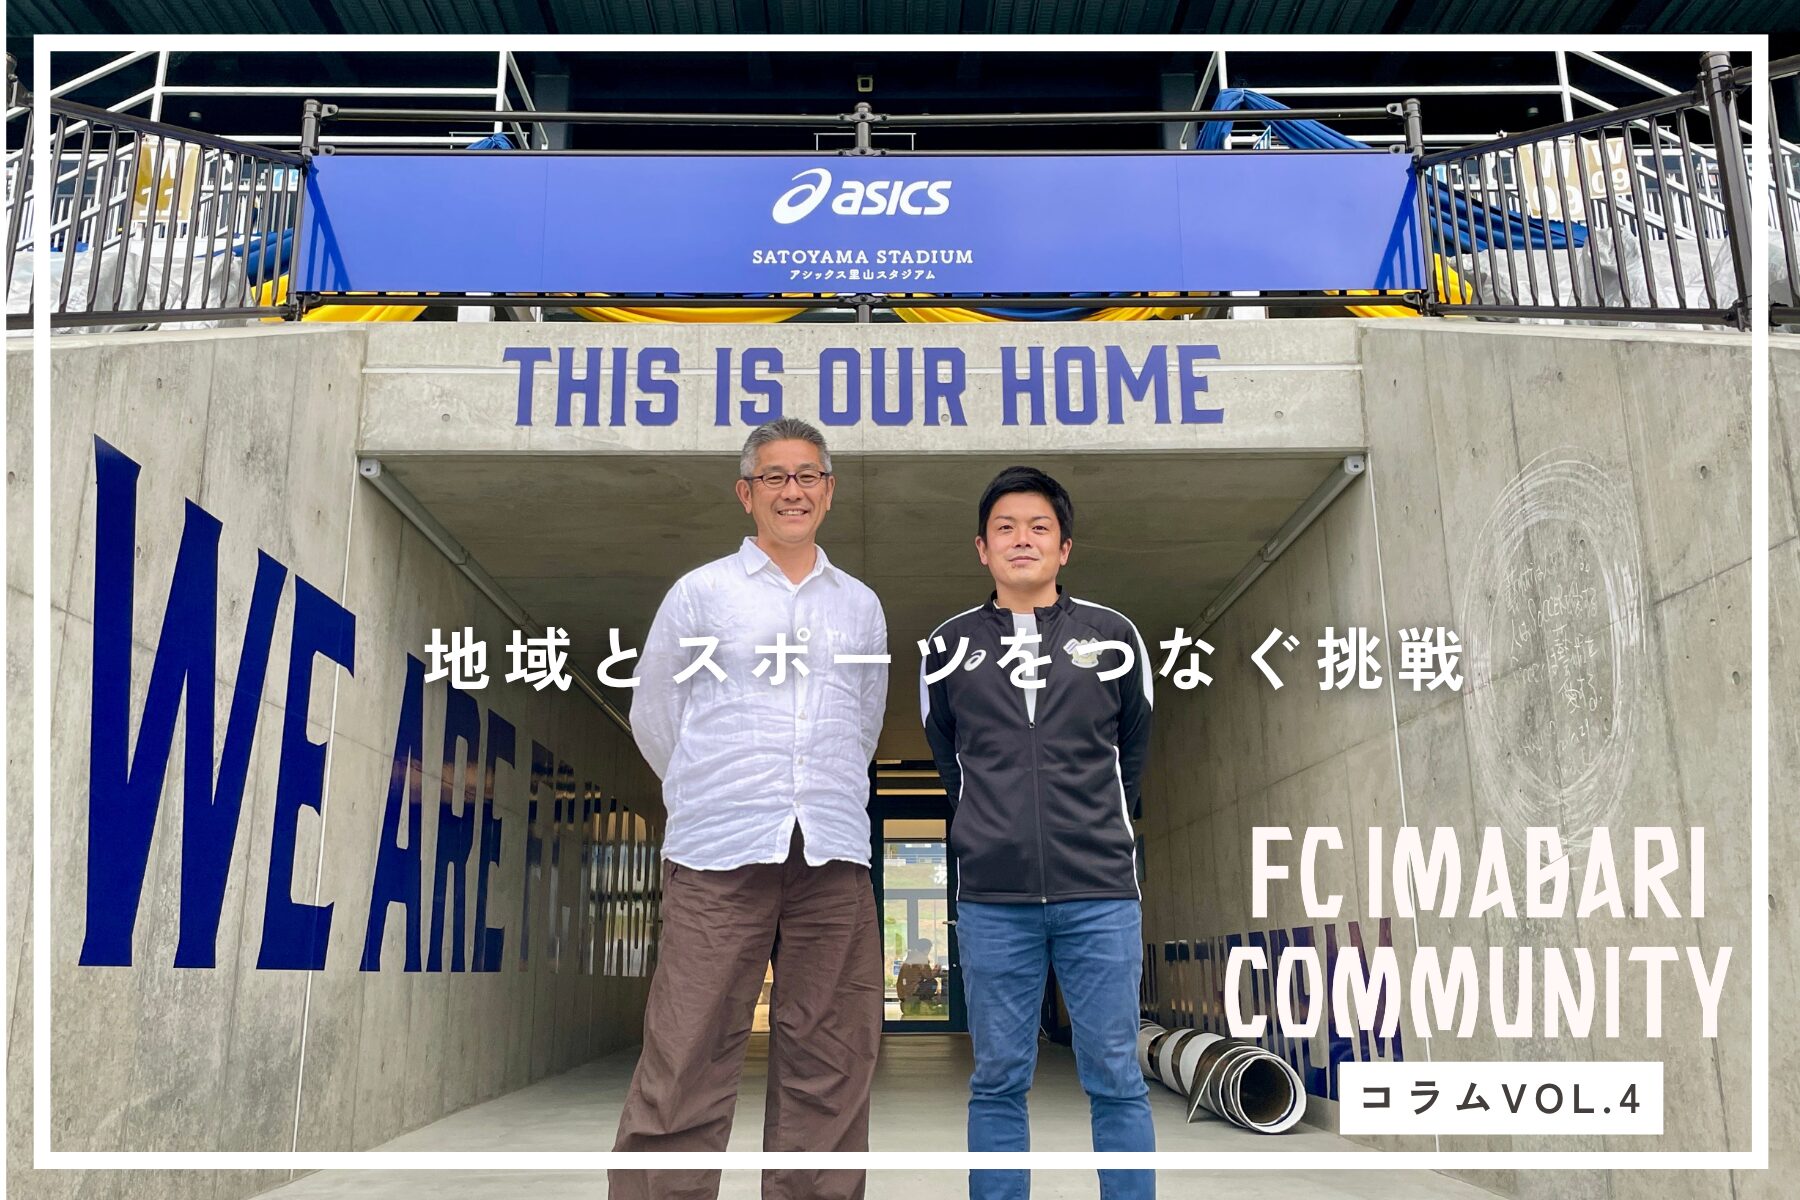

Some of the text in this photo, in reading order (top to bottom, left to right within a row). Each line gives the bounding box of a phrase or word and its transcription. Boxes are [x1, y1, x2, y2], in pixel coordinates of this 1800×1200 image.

[832, 180, 952, 215] asics
[752, 250, 973, 264] SATOYAMA STADIUM
[789, 269, 936, 280] アシックス里山スタジアム
[503, 345, 1225, 426] THIS IS OUR HOME
[78, 434, 356, 971] WE
[359, 652, 516, 973] ARE
